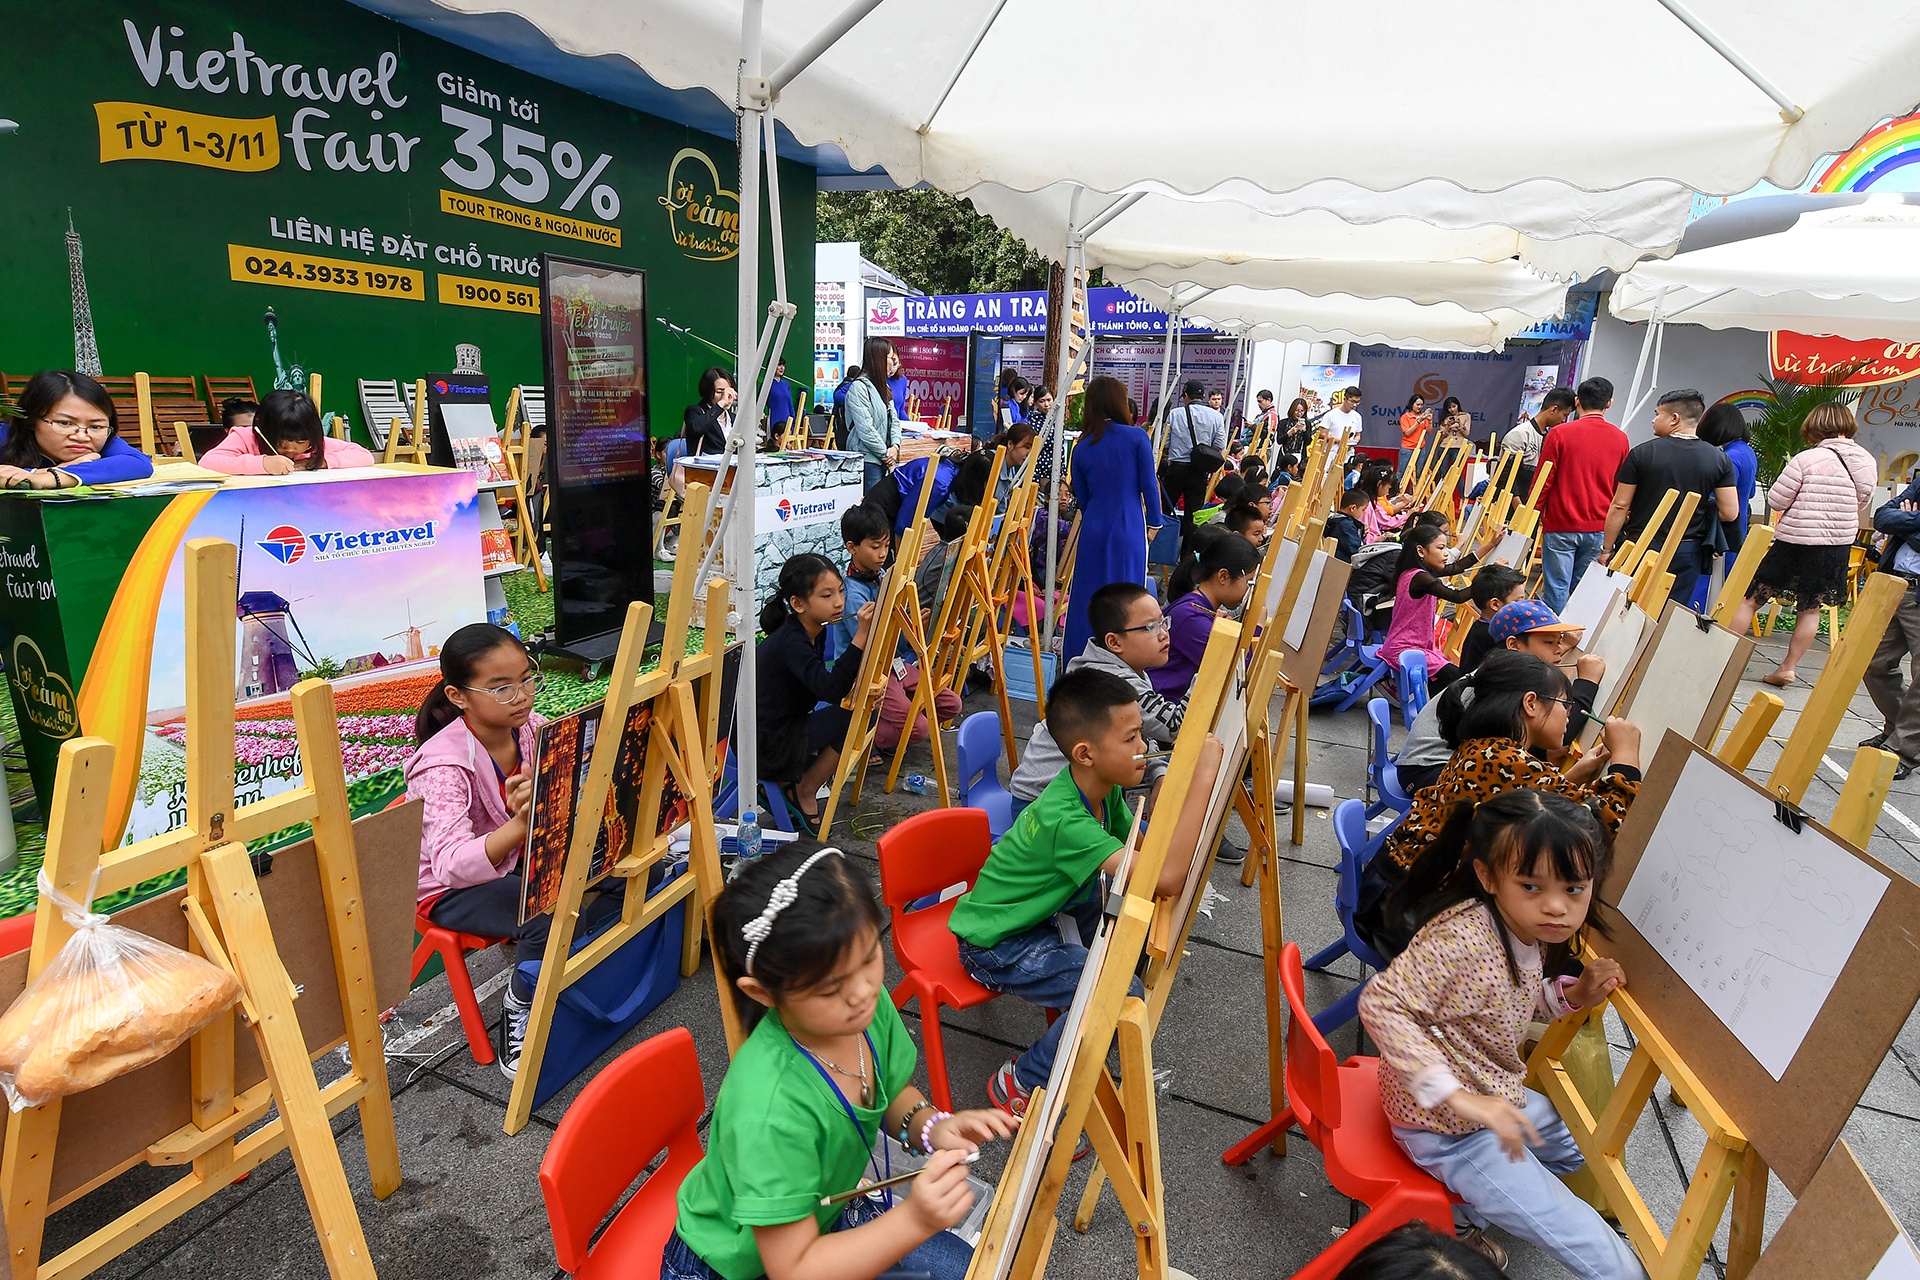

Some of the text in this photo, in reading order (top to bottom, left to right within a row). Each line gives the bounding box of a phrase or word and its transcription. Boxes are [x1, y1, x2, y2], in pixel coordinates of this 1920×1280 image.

[123, 18, 407, 108] Vietravel
[437, 72, 539, 124] Giảm tới
[116, 111, 265, 162] TỪ 1-3/11
[439, 103, 621, 221] 35%
[448, 196, 617, 244] TOUR TRONG & NGOÀI NƯỚC
[686, 195, 739, 231] cảm
[269, 215, 541, 279] LIÊN HỆ ĐẶT CHỖ TRƯỚ
[245, 256, 413, 293] 024.3933 1978
[456, 284, 534, 309] 1900 561
[906, 296, 1047, 320] TRÀNG AN TRA
[1097, 320, 1124, 331] THÁNH
[1217, 348, 1236, 356] 0079
[792, 499, 836, 516] Vietravel
[310, 521, 434, 552] Vietravel
[0, 544, 39, 569] etravel
[36, 578, 57, 600] 201
